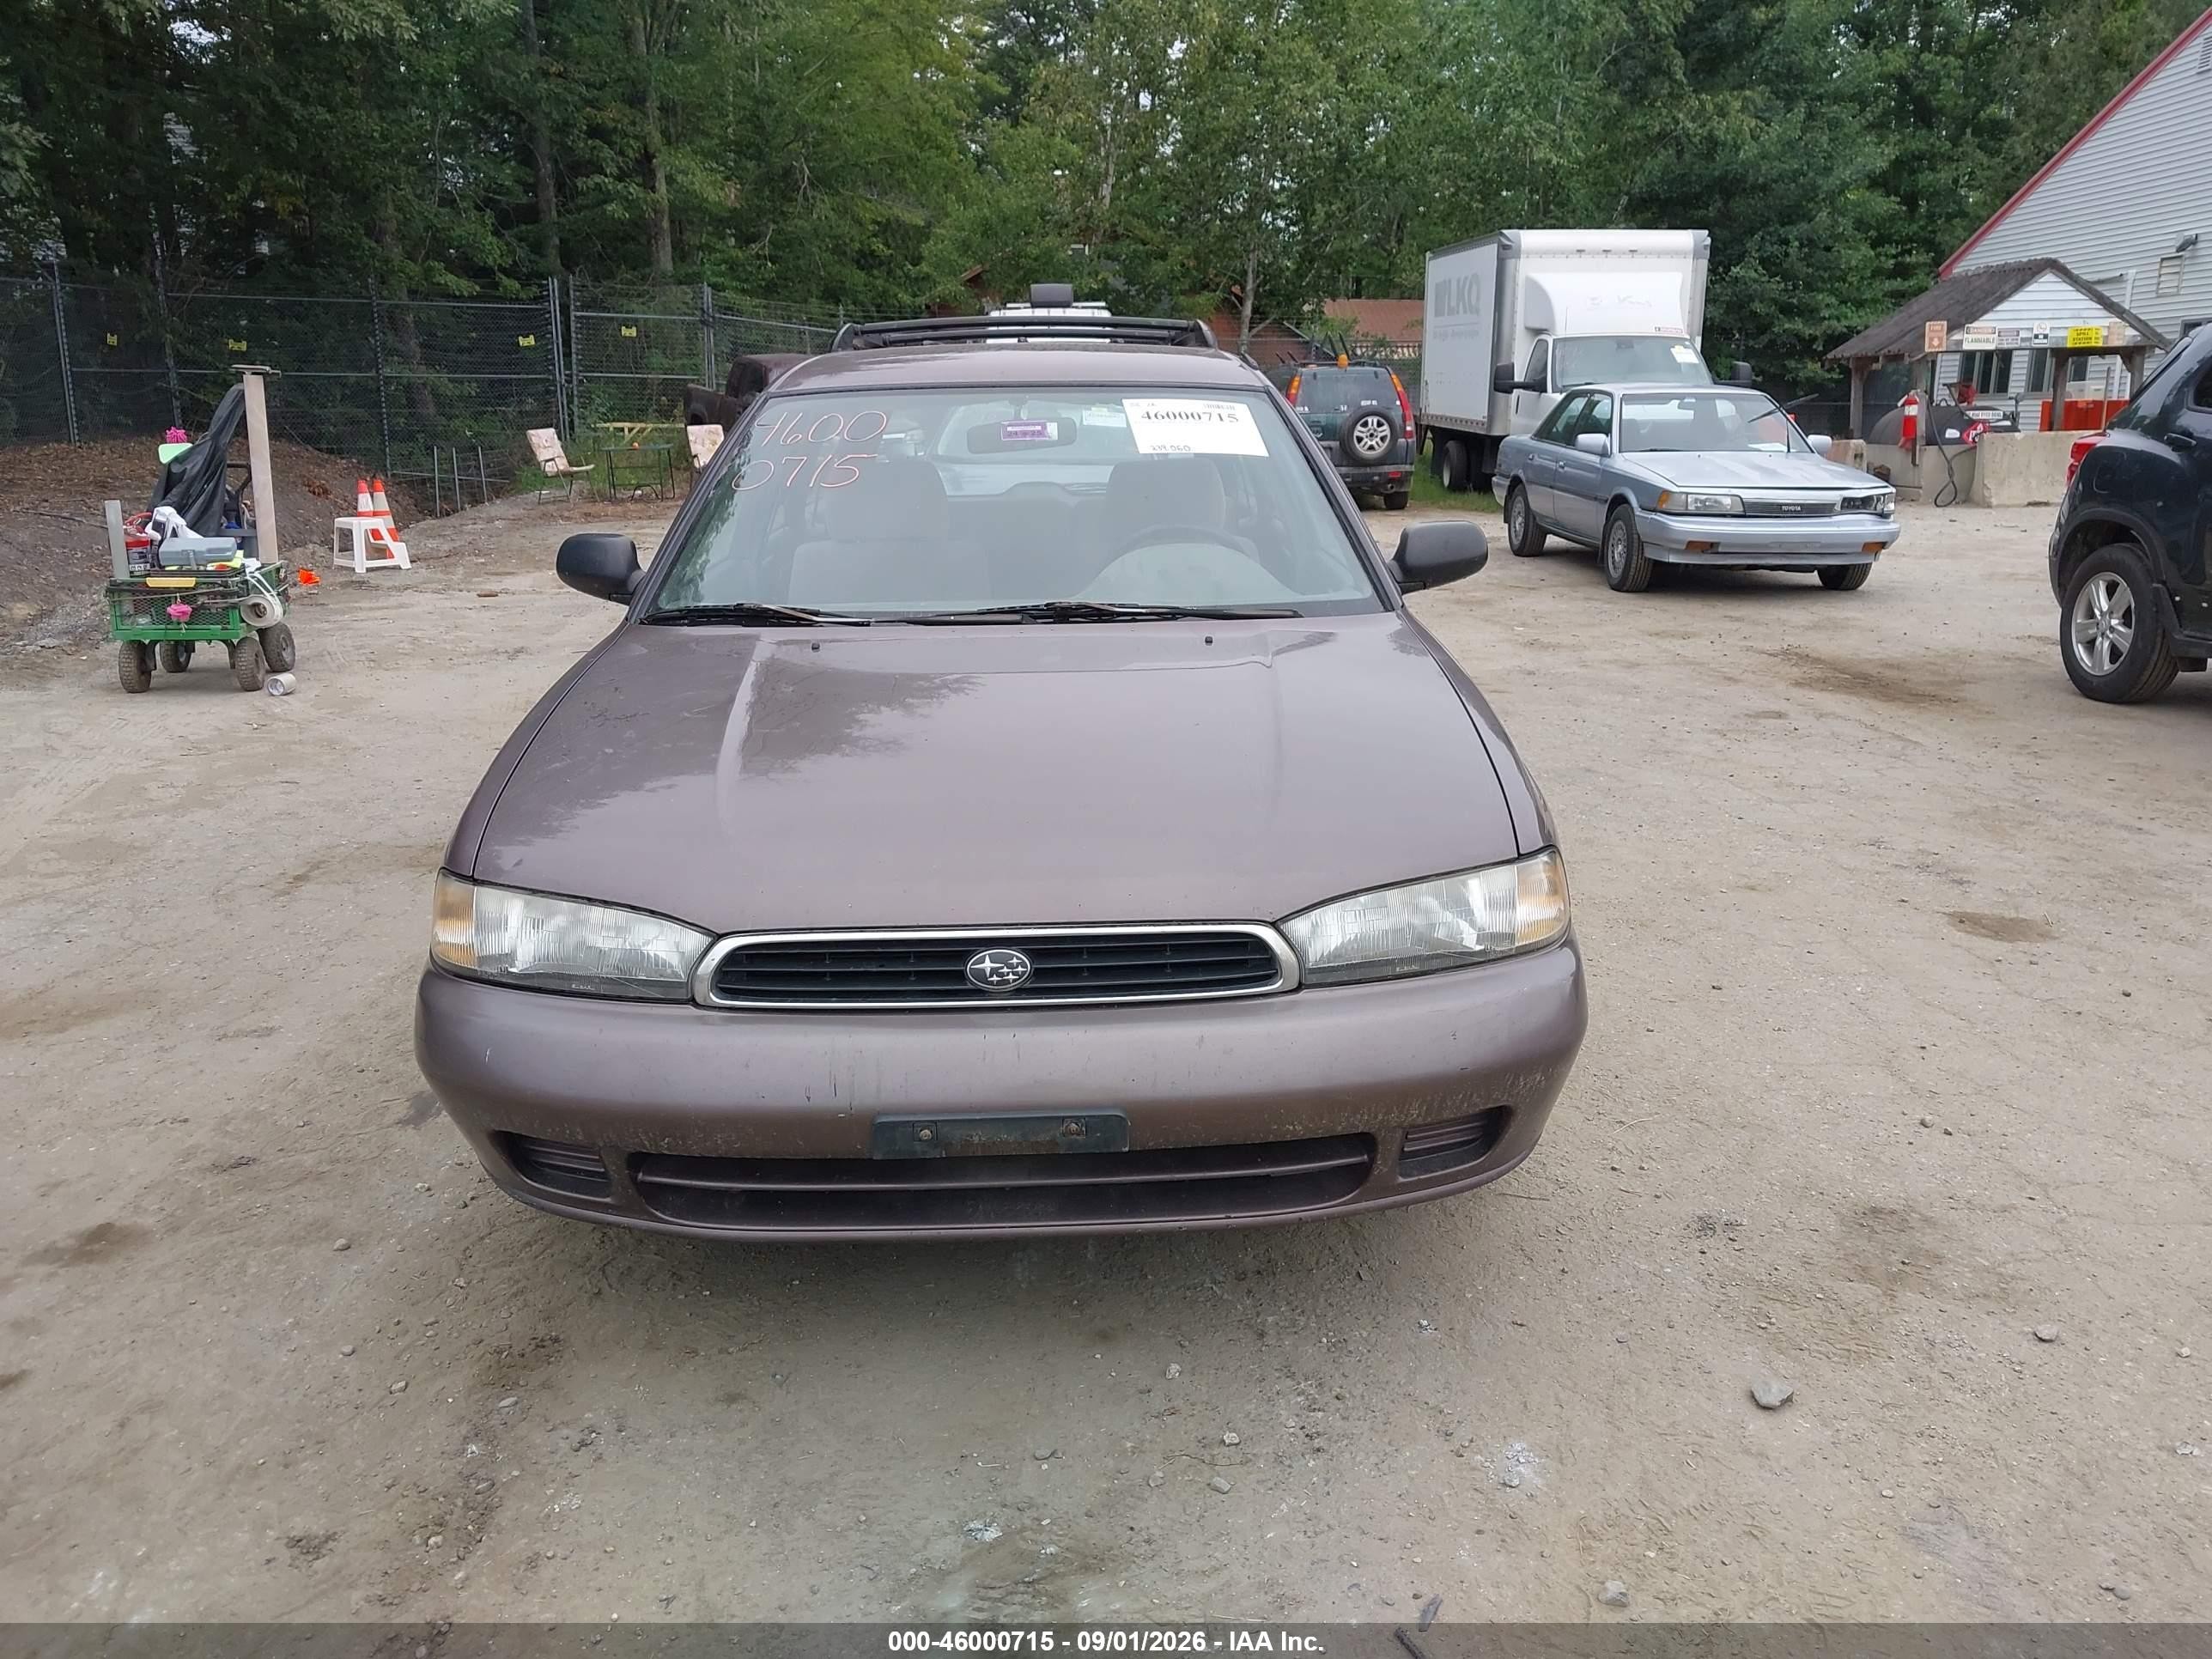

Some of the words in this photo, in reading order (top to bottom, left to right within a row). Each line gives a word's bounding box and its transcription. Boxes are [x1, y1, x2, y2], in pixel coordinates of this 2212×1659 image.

[1964, 336, 1996, 344] FLAMMABLE
[1140, 410, 1239, 422] 46000715
[754, 410, 887, 447] 4600
[732, 453, 878, 490] 0715
